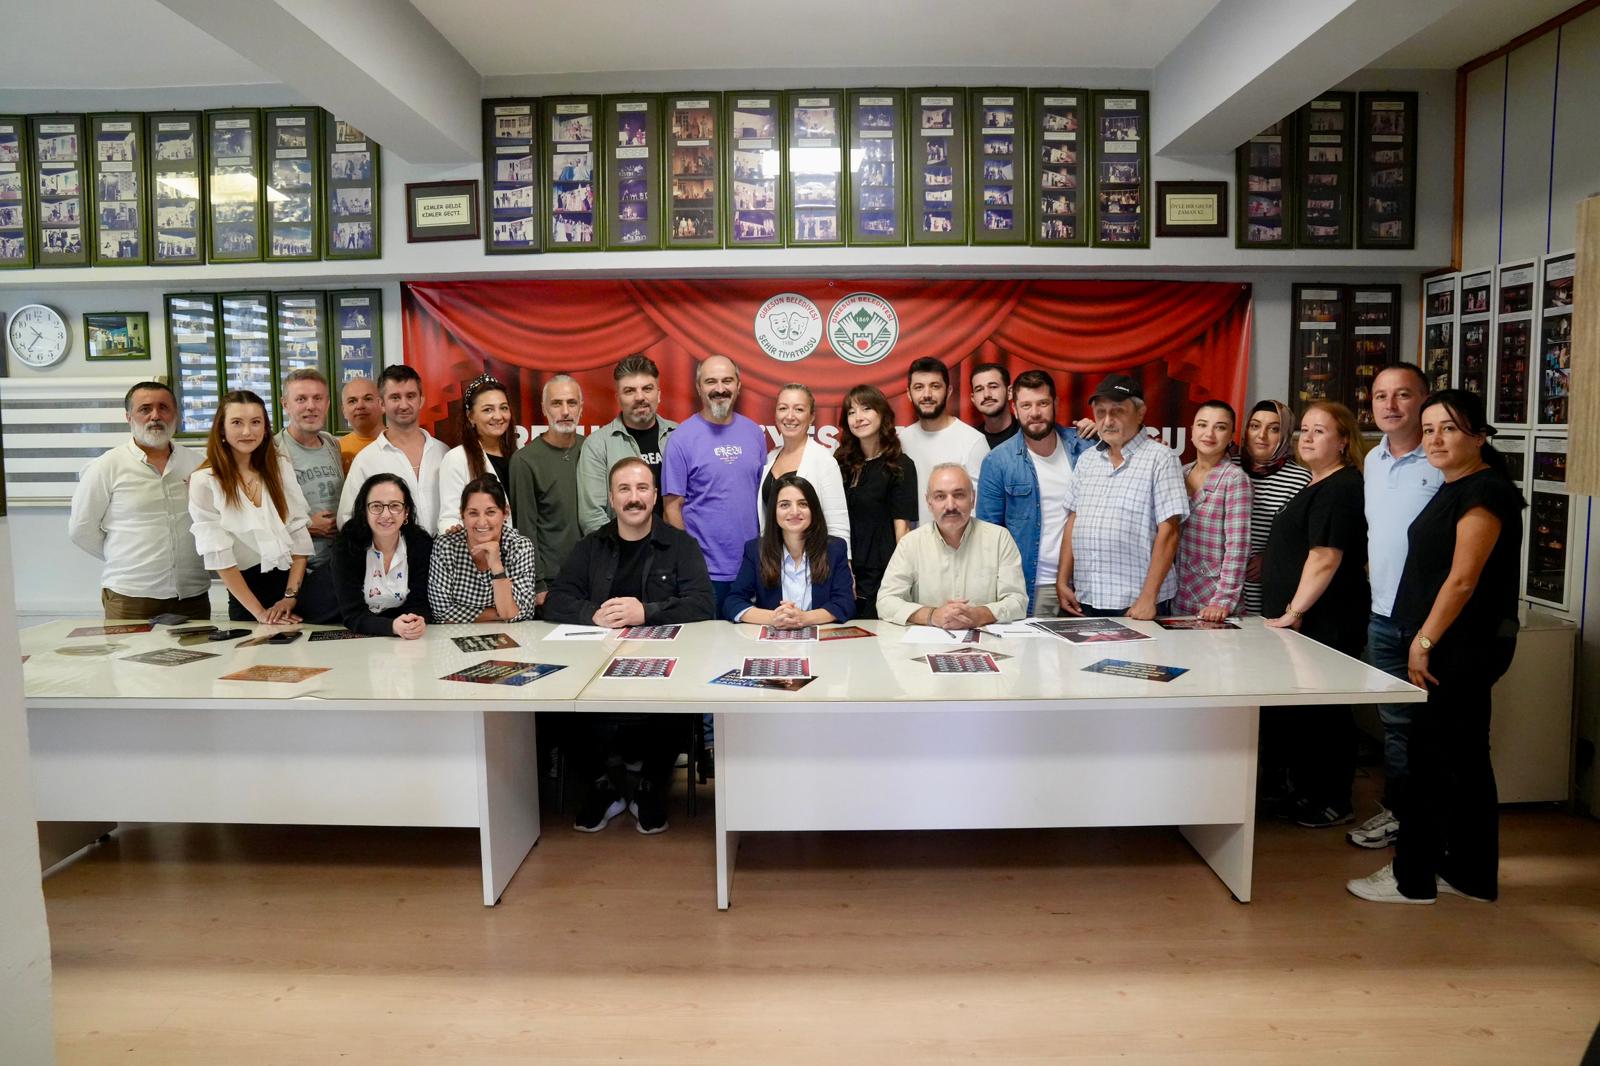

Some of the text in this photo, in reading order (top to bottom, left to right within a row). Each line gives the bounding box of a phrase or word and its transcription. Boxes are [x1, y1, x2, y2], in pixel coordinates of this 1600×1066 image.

[760, 296, 819, 320] GİRESUN BELEDİYESİ
[832, 297, 894, 323] GİRESUN BELEDİYESİ
[778, 337, 817, 358] TİYATROSU
